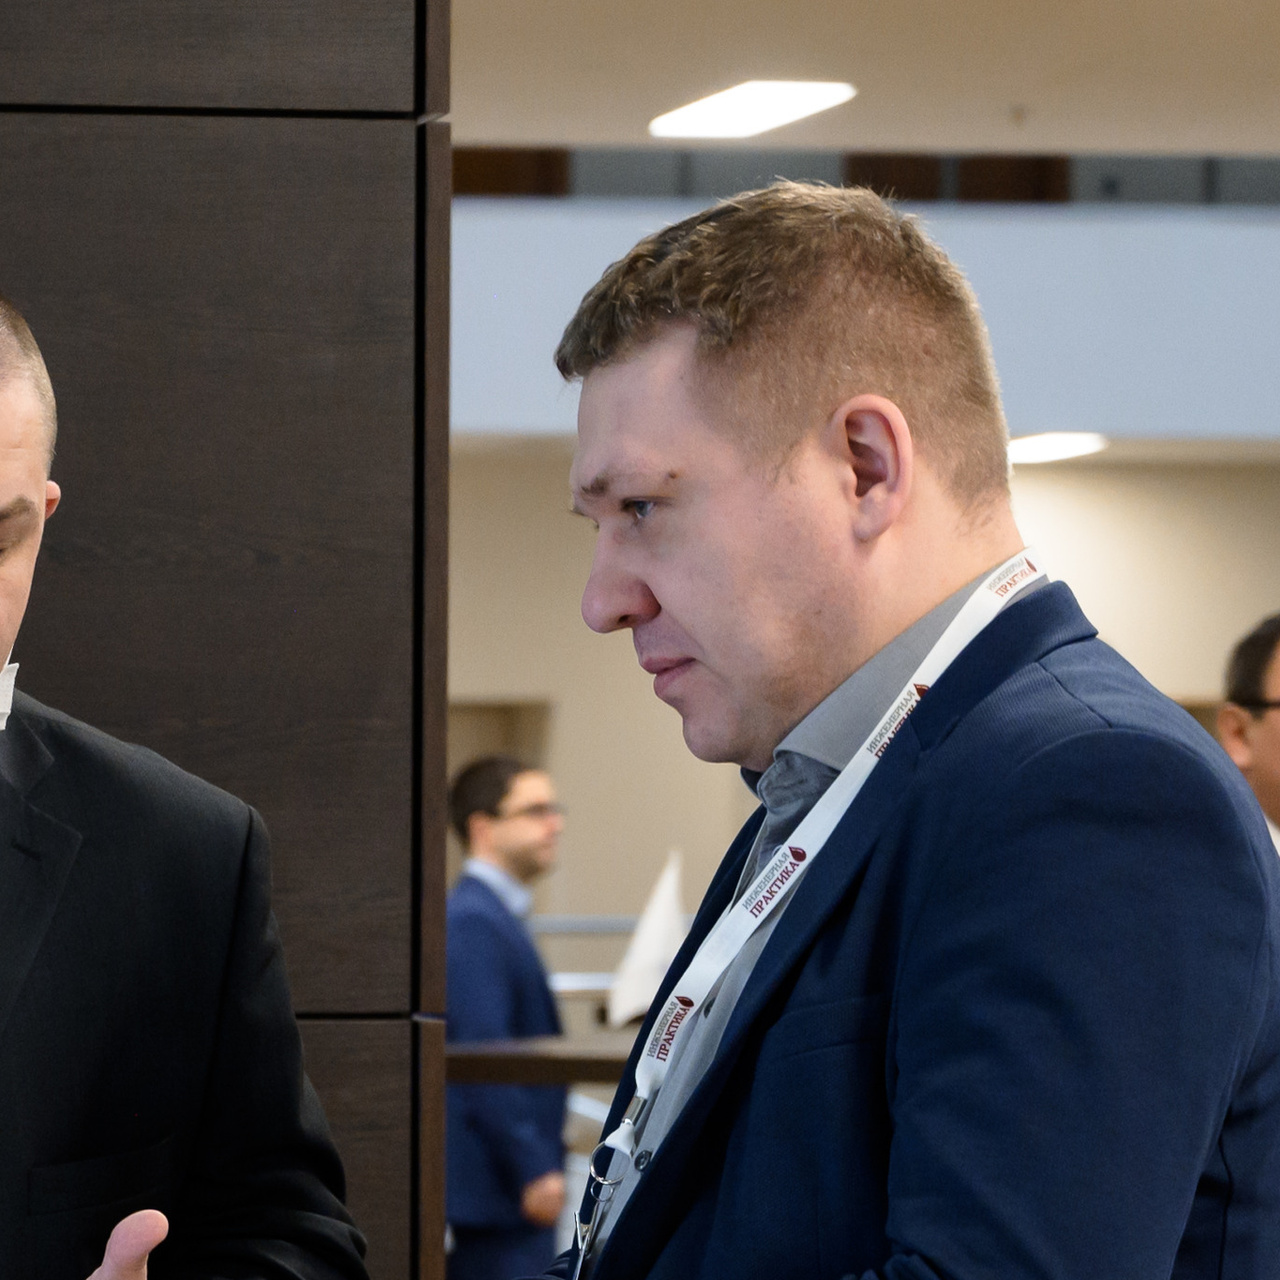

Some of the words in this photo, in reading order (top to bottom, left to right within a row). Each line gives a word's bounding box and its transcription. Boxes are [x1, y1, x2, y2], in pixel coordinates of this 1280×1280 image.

[866, 689, 916, 754] ИНЖЕНЕРНАЯ
[742, 851, 791, 910] ИНЖЕНЕРНАЯ
[749, 861, 800, 919] ПРАКТИКА
[646, 1000, 679, 1058] ИНЖЕНЕРНАЯ
[656, 1007, 690, 1062] ПРАКТИКА
